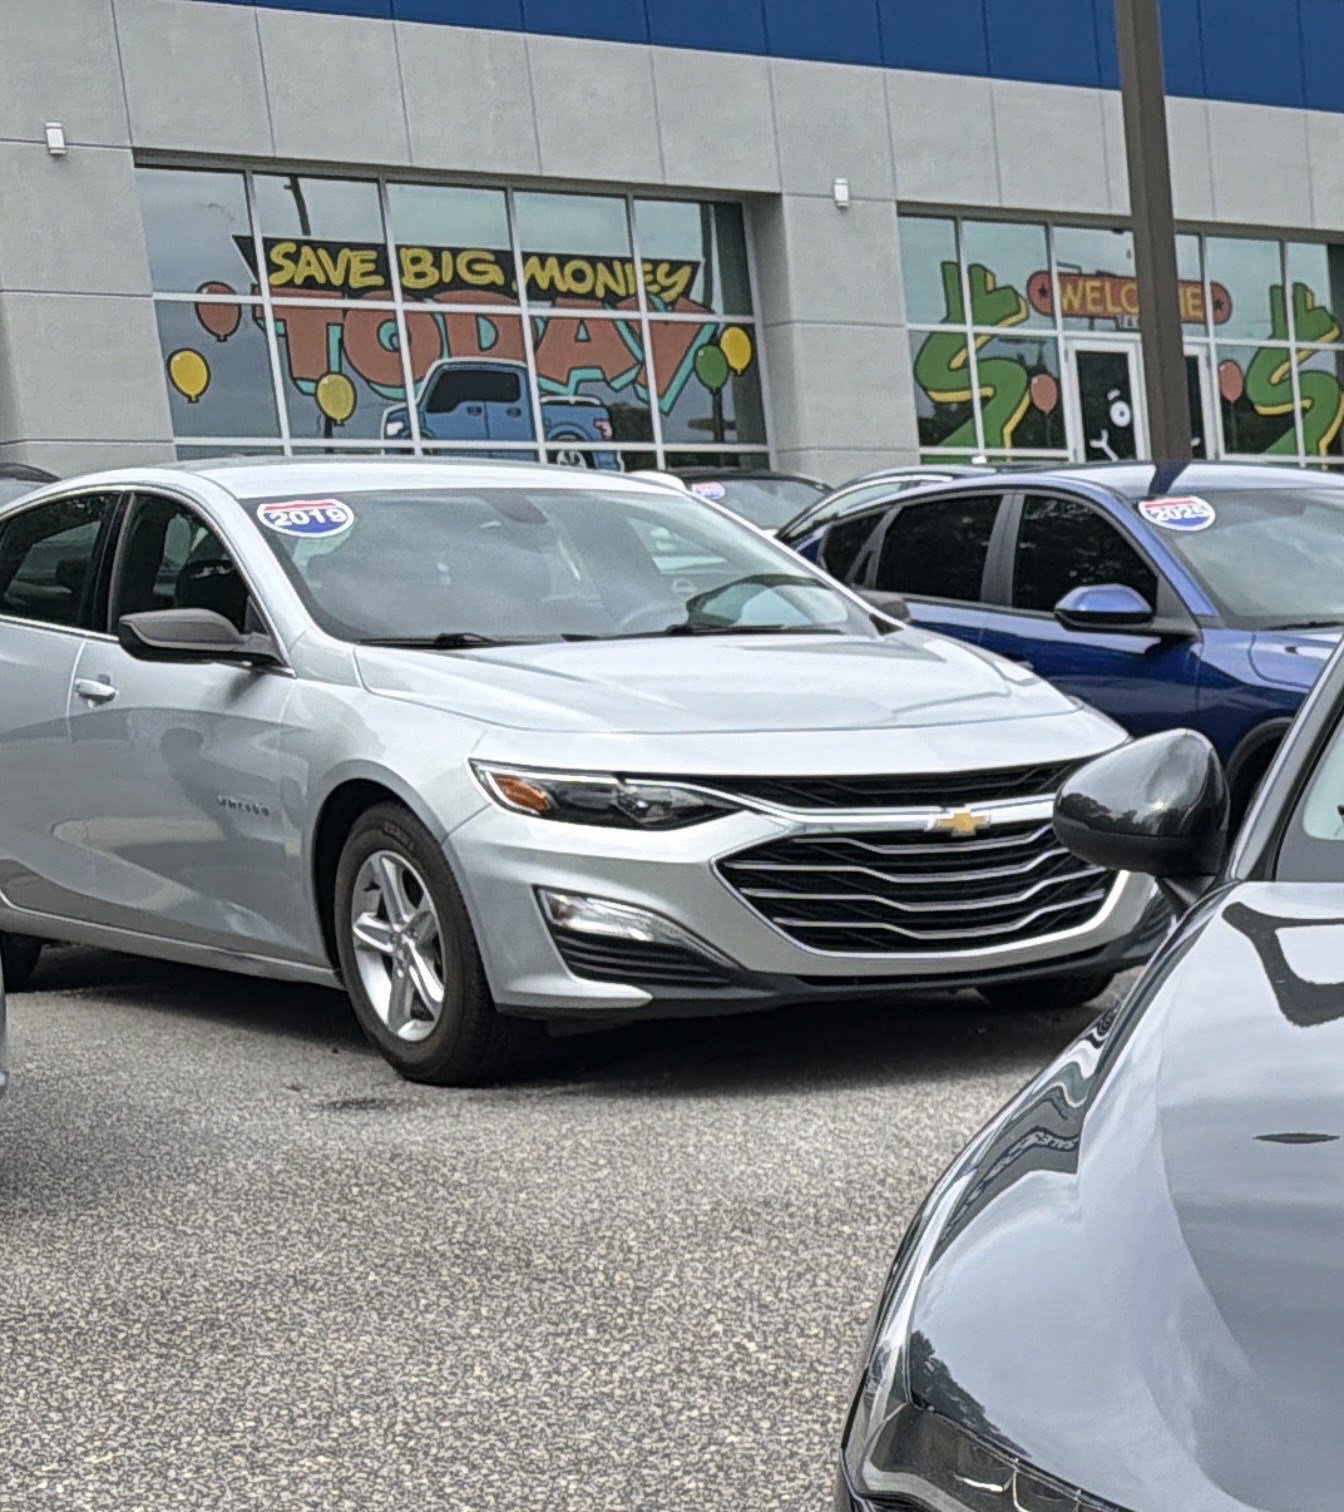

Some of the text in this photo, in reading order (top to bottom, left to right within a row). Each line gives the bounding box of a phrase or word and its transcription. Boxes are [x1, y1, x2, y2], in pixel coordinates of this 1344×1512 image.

[269, 242, 693, 300] SAVE BIG MONEY
[1061, 278, 1204, 326] WELCE
[253, 286, 714, 414] TODAY
[269, 508, 348, 526] 2019
